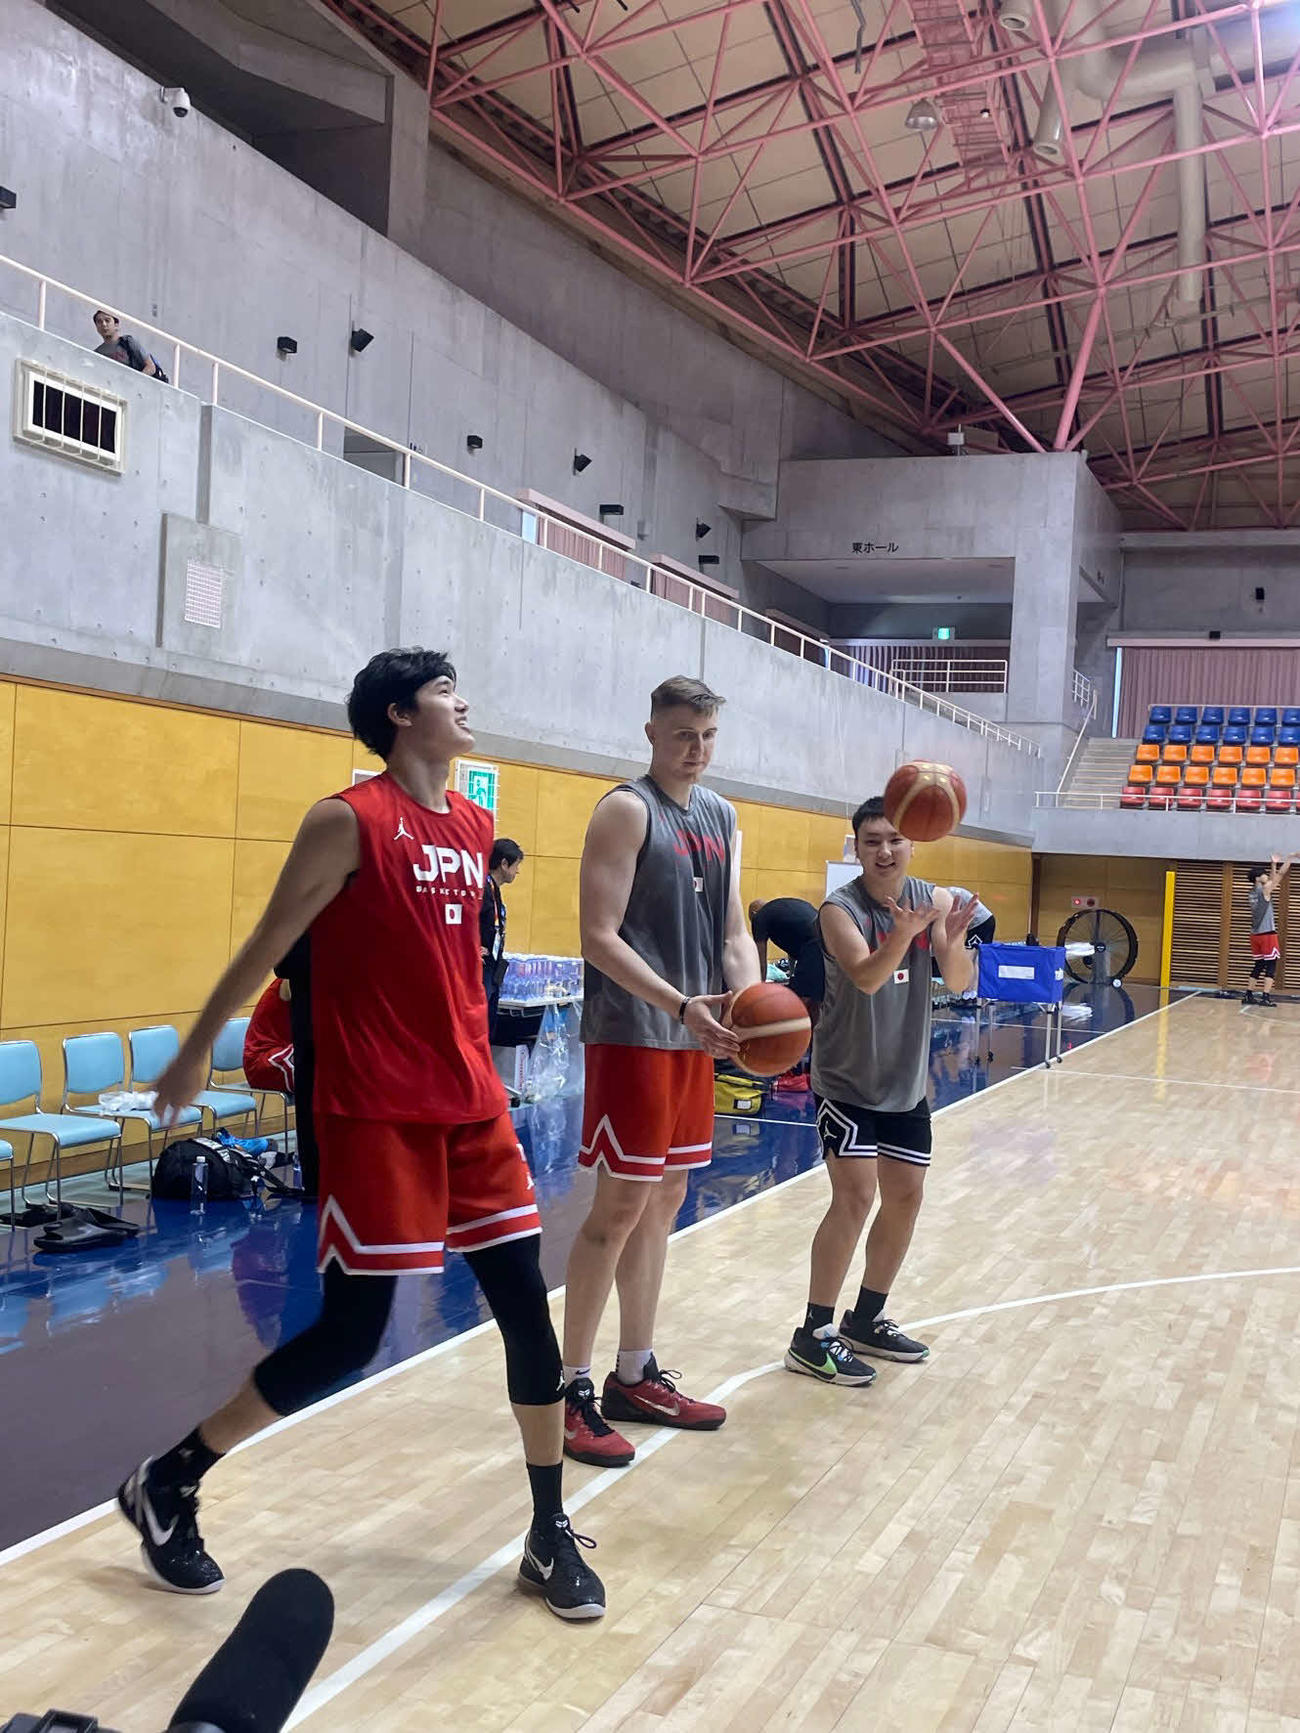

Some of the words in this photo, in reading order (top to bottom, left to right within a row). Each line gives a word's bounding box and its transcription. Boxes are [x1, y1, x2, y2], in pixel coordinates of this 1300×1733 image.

[851, 541, 899, 554] 東ホール
[412, 844, 484, 889] JPN
